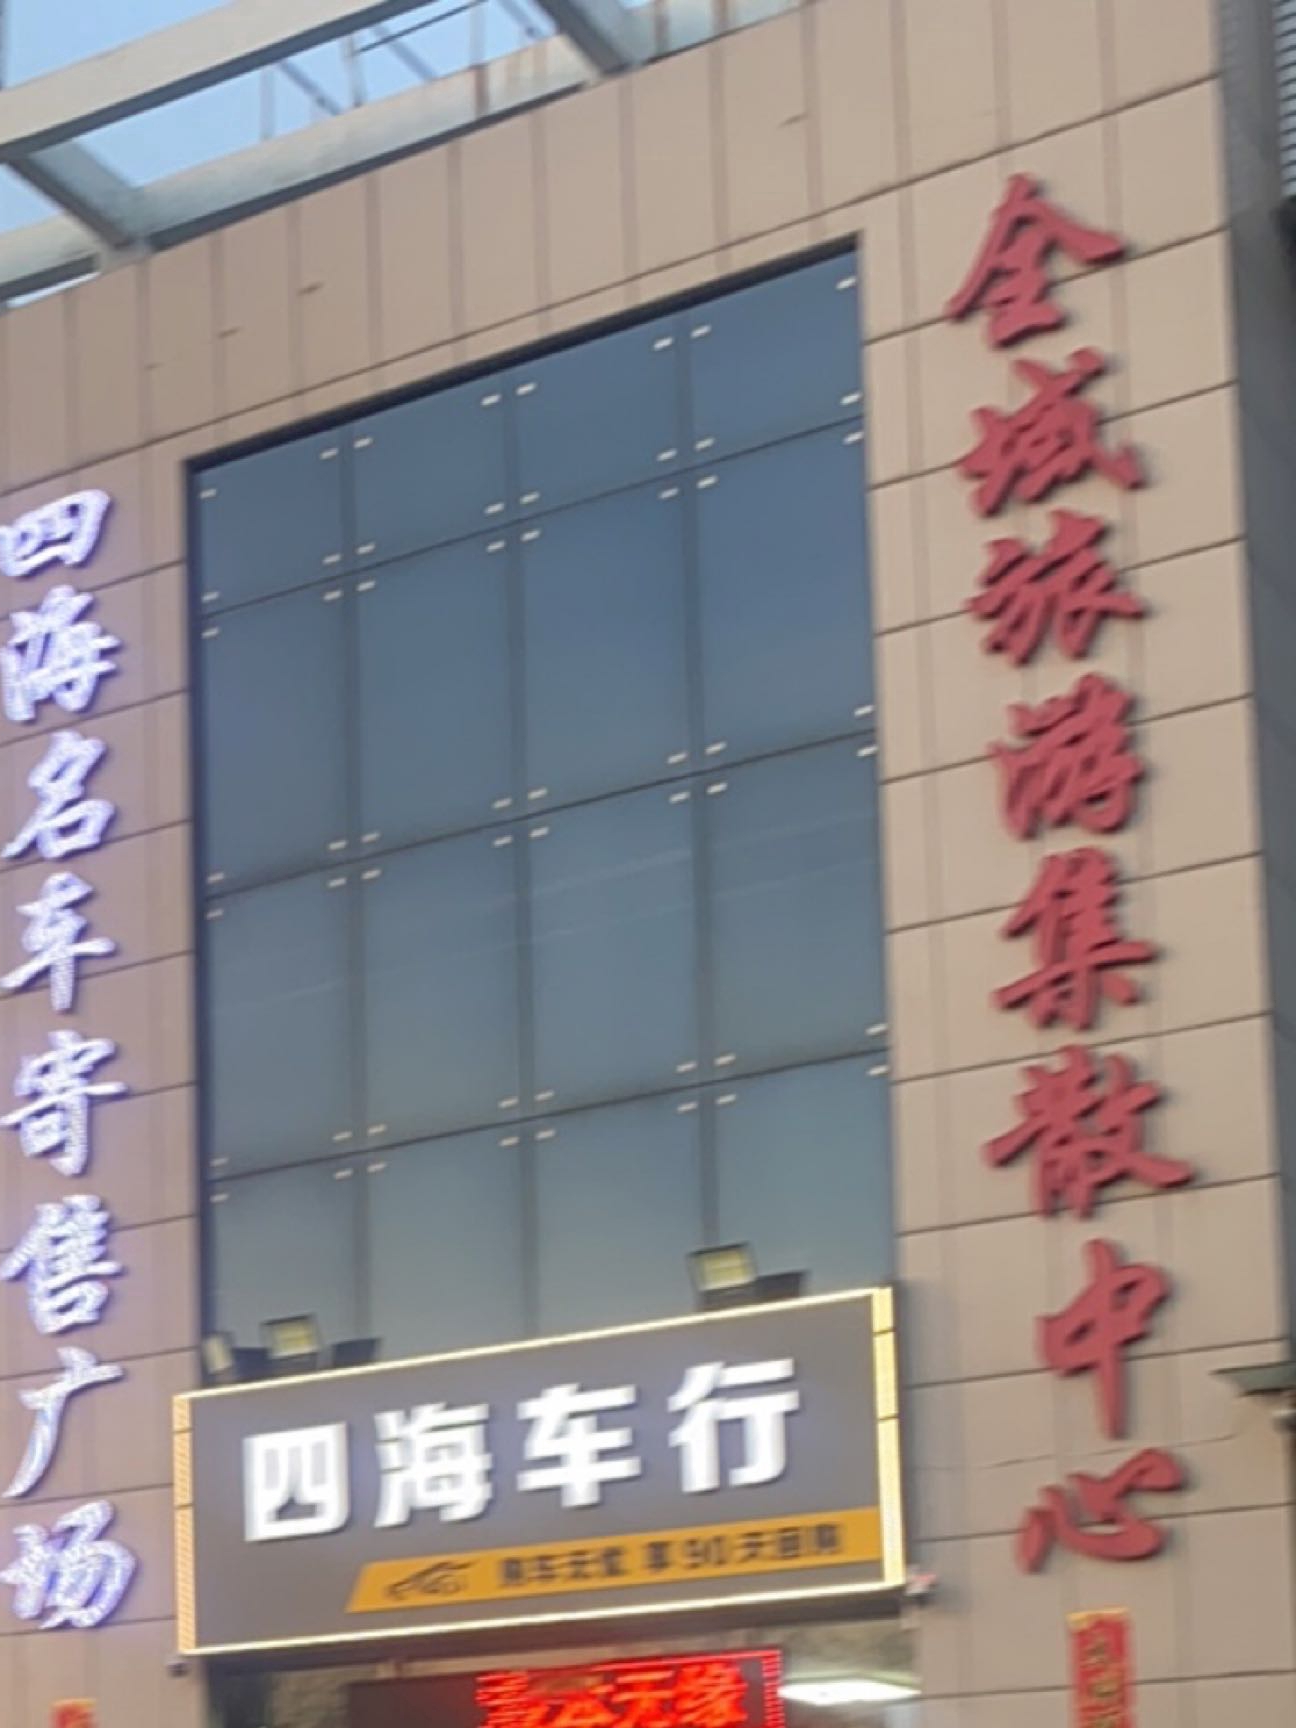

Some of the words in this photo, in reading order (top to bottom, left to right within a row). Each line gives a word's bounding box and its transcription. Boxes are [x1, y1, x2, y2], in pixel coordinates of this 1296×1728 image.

[943, 171, 1194, 1576] 全域旅游集散中心
[242, 1356, 802, 1544] 四海车行
